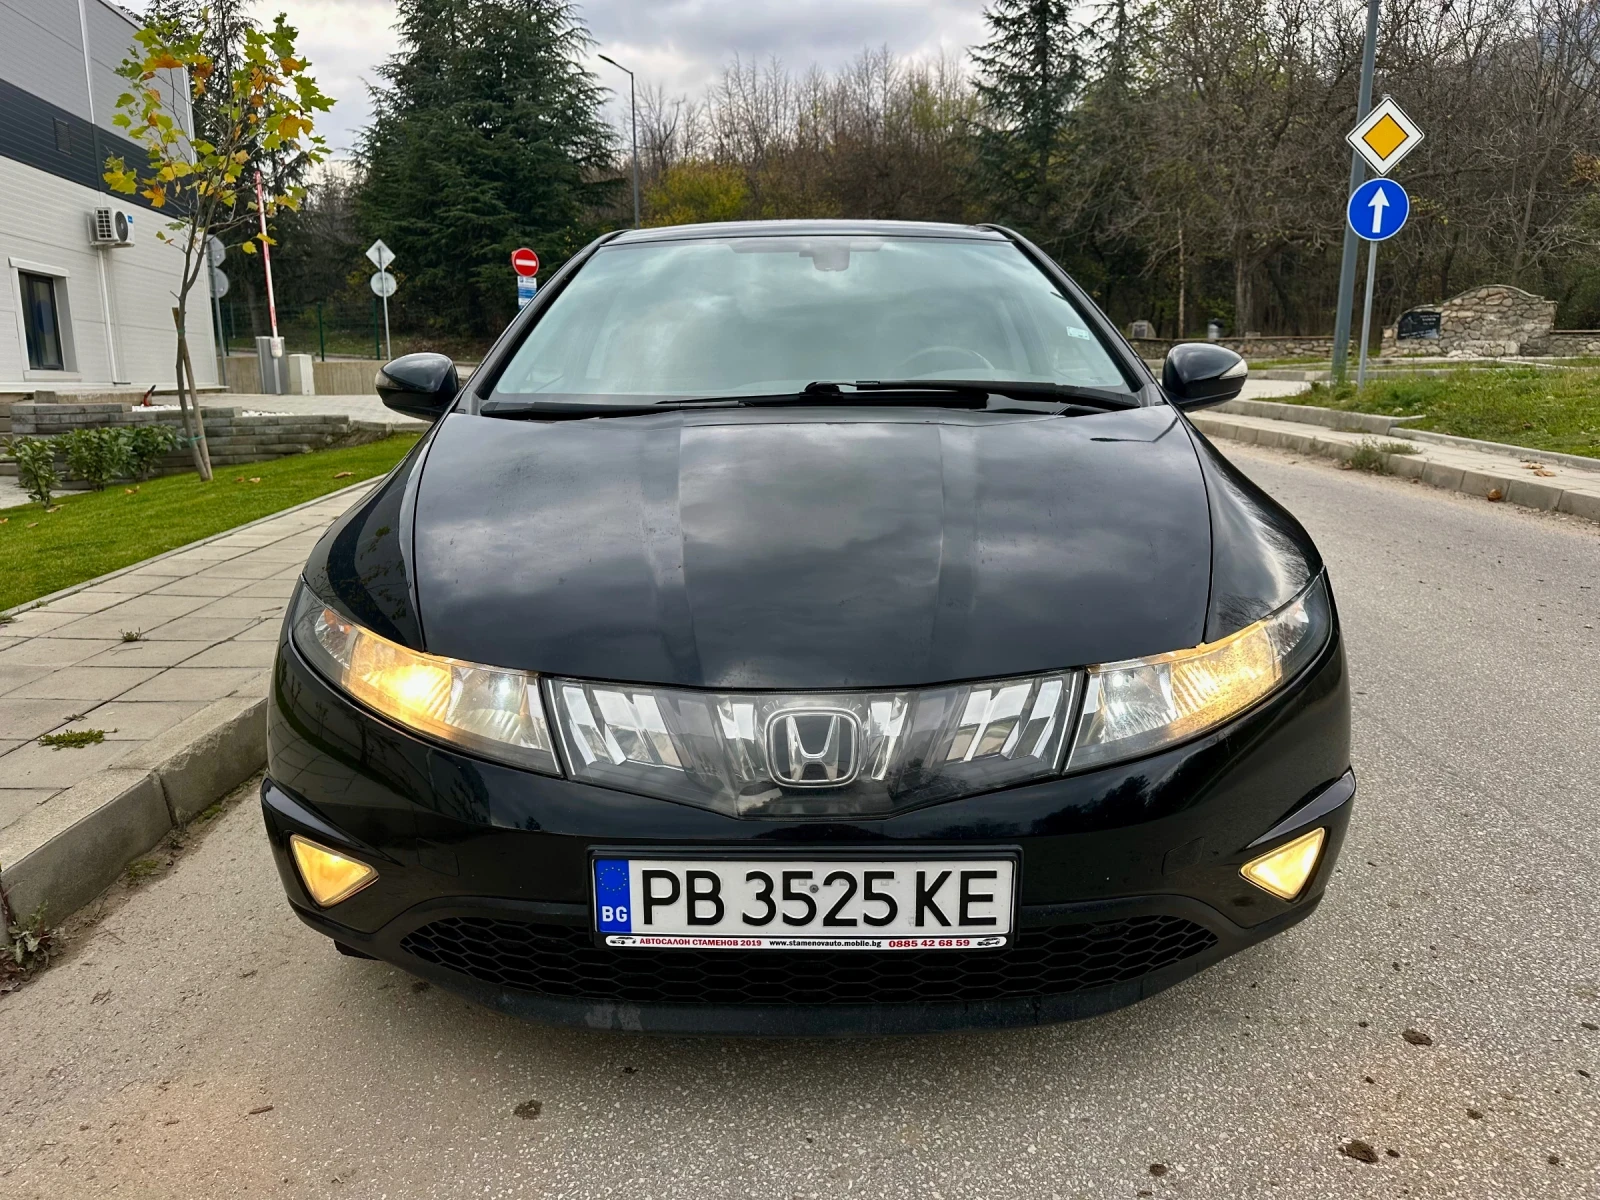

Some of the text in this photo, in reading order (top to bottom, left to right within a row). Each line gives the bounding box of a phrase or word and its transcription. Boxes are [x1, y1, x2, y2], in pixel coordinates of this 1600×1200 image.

[642, 869, 999, 928] PB 3525 KE
[601, 905, 628, 924] BG
[639, 937, 762, 947] АВТОСАЛОН СТАМЕНОВ 2019
[769, 939, 882, 949] www.stamenovauto.mobile.bg
[888, 939, 918, 948] 0885
